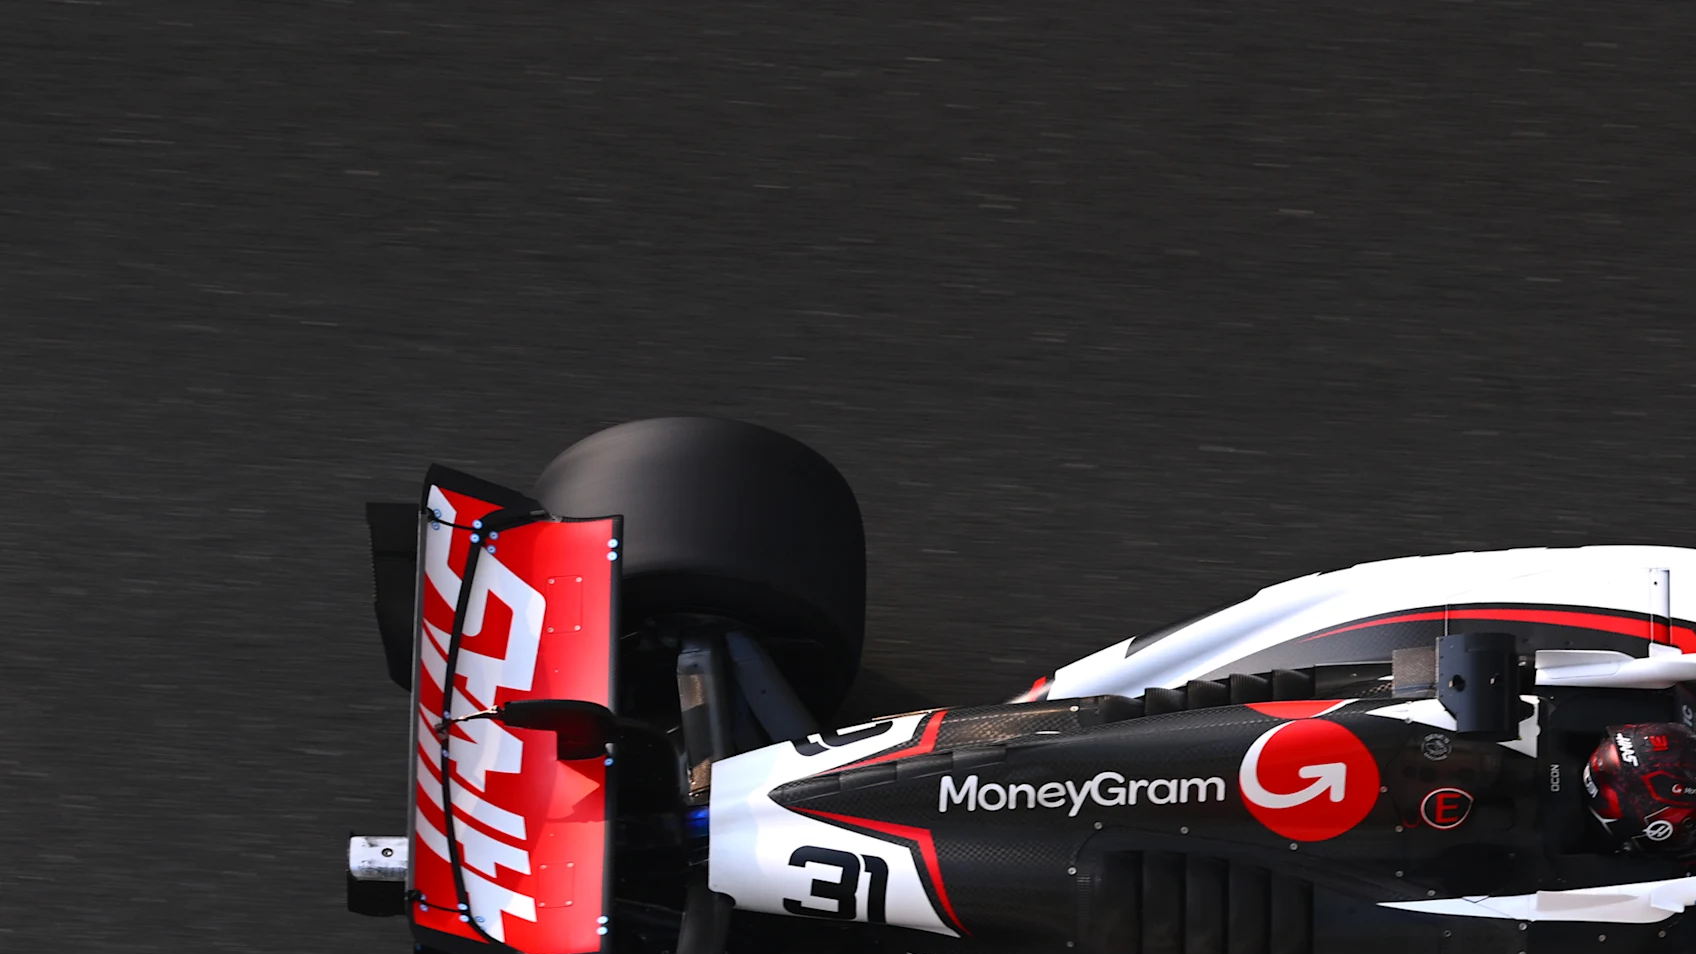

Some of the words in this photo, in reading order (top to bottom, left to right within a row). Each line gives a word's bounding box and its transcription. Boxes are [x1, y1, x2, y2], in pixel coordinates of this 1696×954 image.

[938, 771, 1225, 817] MoneyGram
[1550, 764, 1560, 792] OCON
[1435, 793, 1461, 823] E
[782, 845, 888, 924] 31
